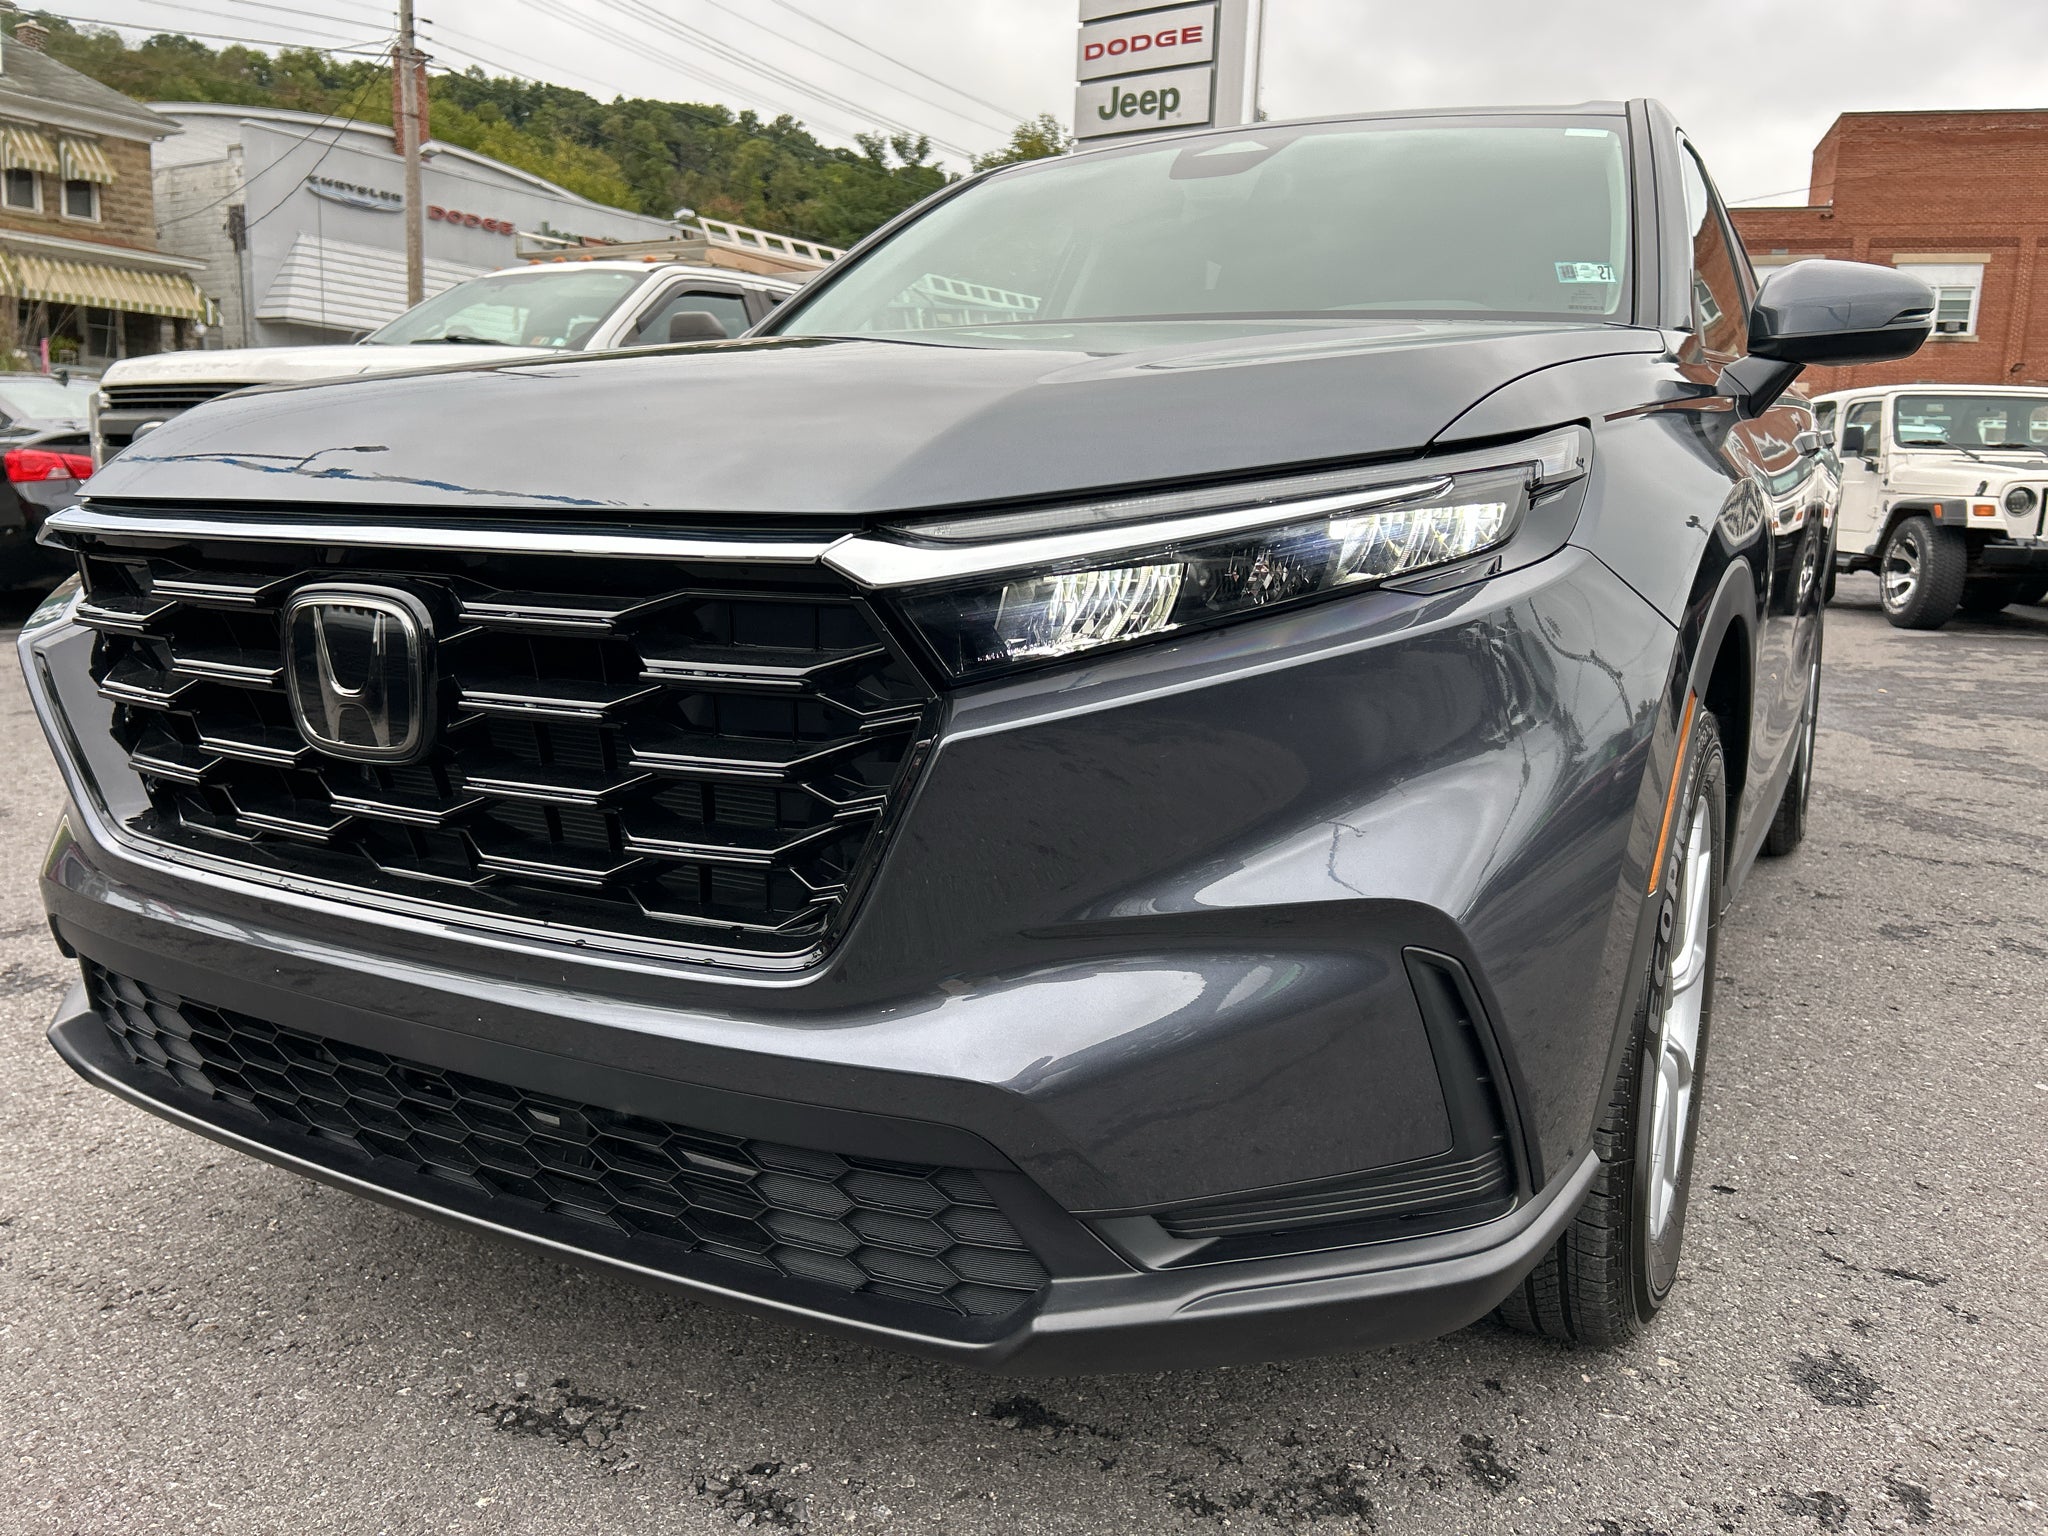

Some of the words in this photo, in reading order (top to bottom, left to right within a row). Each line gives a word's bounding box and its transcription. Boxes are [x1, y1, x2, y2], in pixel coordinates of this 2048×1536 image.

[1084, 25, 1204, 61] DODGE
[1097, 86, 1181, 120] Jeep
[306, 174, 404, 203] CHRYSLER
[427, 204, 515, 236] DODGE
[1596, 265, 1612, 280] 27
